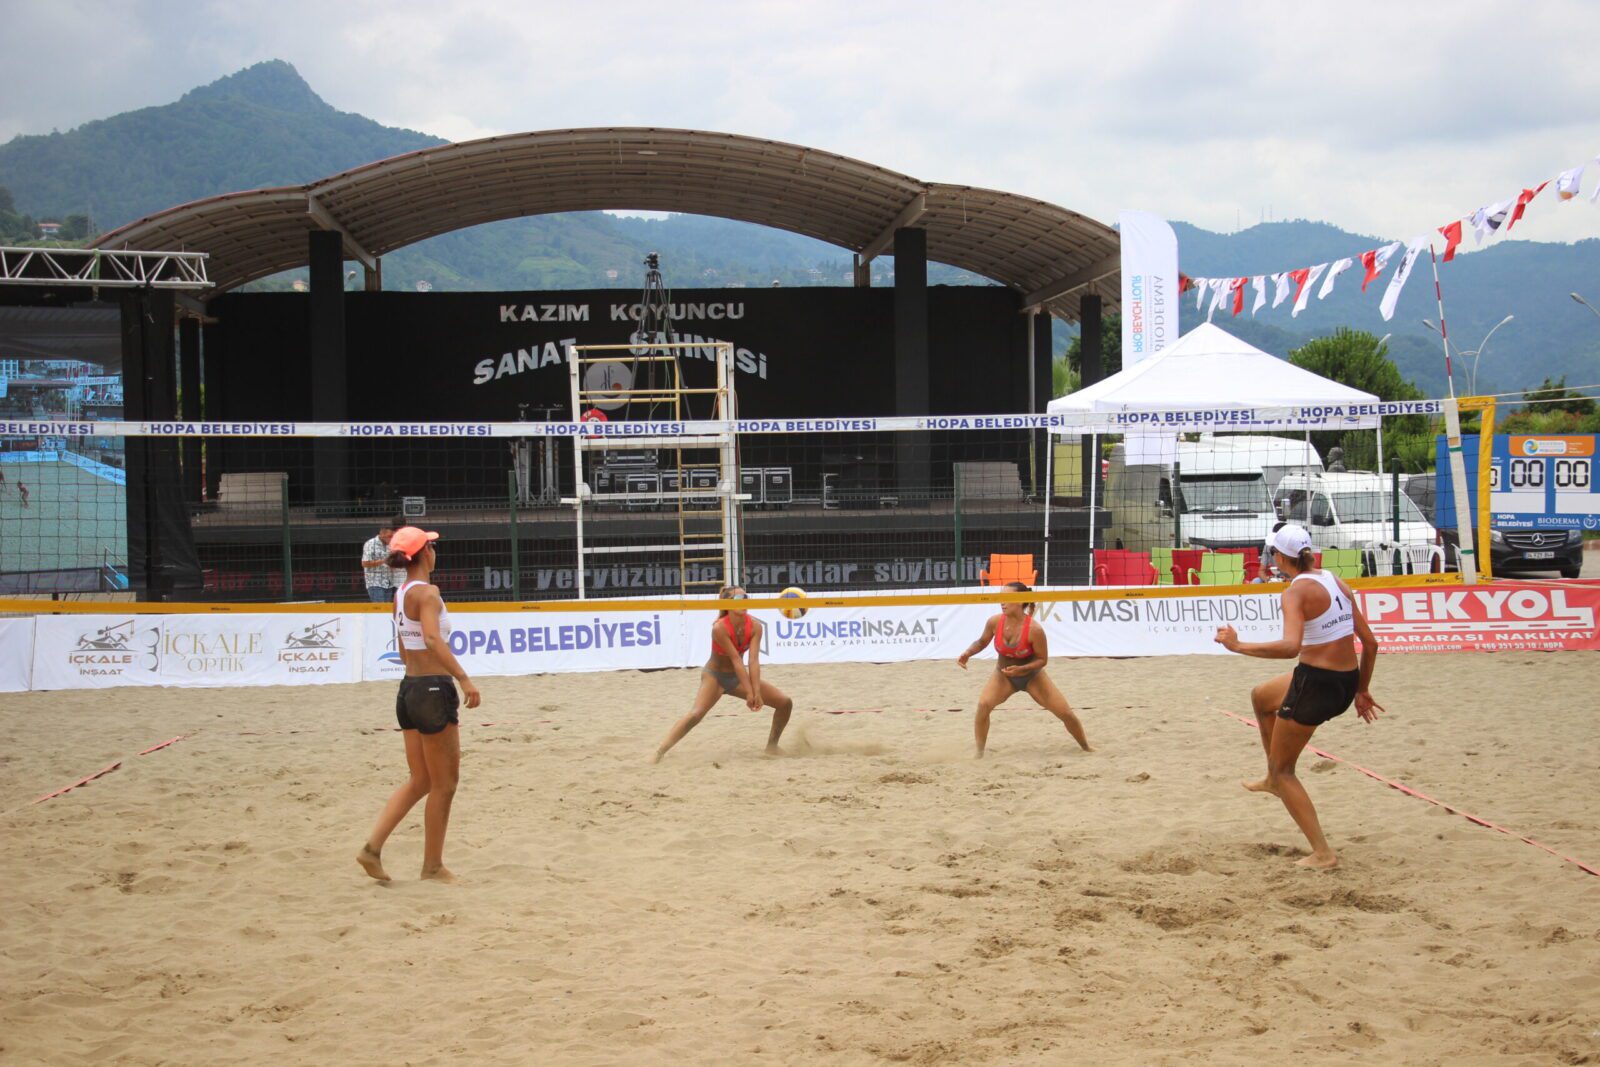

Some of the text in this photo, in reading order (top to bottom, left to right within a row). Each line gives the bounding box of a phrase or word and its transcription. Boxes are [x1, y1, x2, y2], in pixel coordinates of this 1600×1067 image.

[500, 303, 744, 322] KAZIM KOYUNCU
[473, 331, 767, 384] SANAT SAHNSİ
[1117, 413, 1160, 424] HOPA
[1165, 409, 1255, 422] BELEDİYESİ
[1300, 401, 1440, 418] HOPA BELEDİYESİ
[150, 422, 295, 435] HOPA BELEDİYESİ
[350, 423, 492, 435] HOPA BELEDİYESİ
[545, 422, 685, 435] HOPA BELEDİYESİ
[738, 419, 876, 432] HOPA BELEDİYESİ
[926, 415, 1065, 429] HOPA BELEDİYESİ
[1511, 460, 1543, 486] 00
[1556, 461, 1588, 487] 00
[537, 563, 718, 590] yeryüzünde
[1335, 596, 1343, 610] 1
[399, 612, 404, 626] 2
[449, 614, 661, 656] OPA BELEDİYESİ
[1496, 631, 1594, 641] NAKLİYAT
[164, 629, 262, 660] İÇKALE
